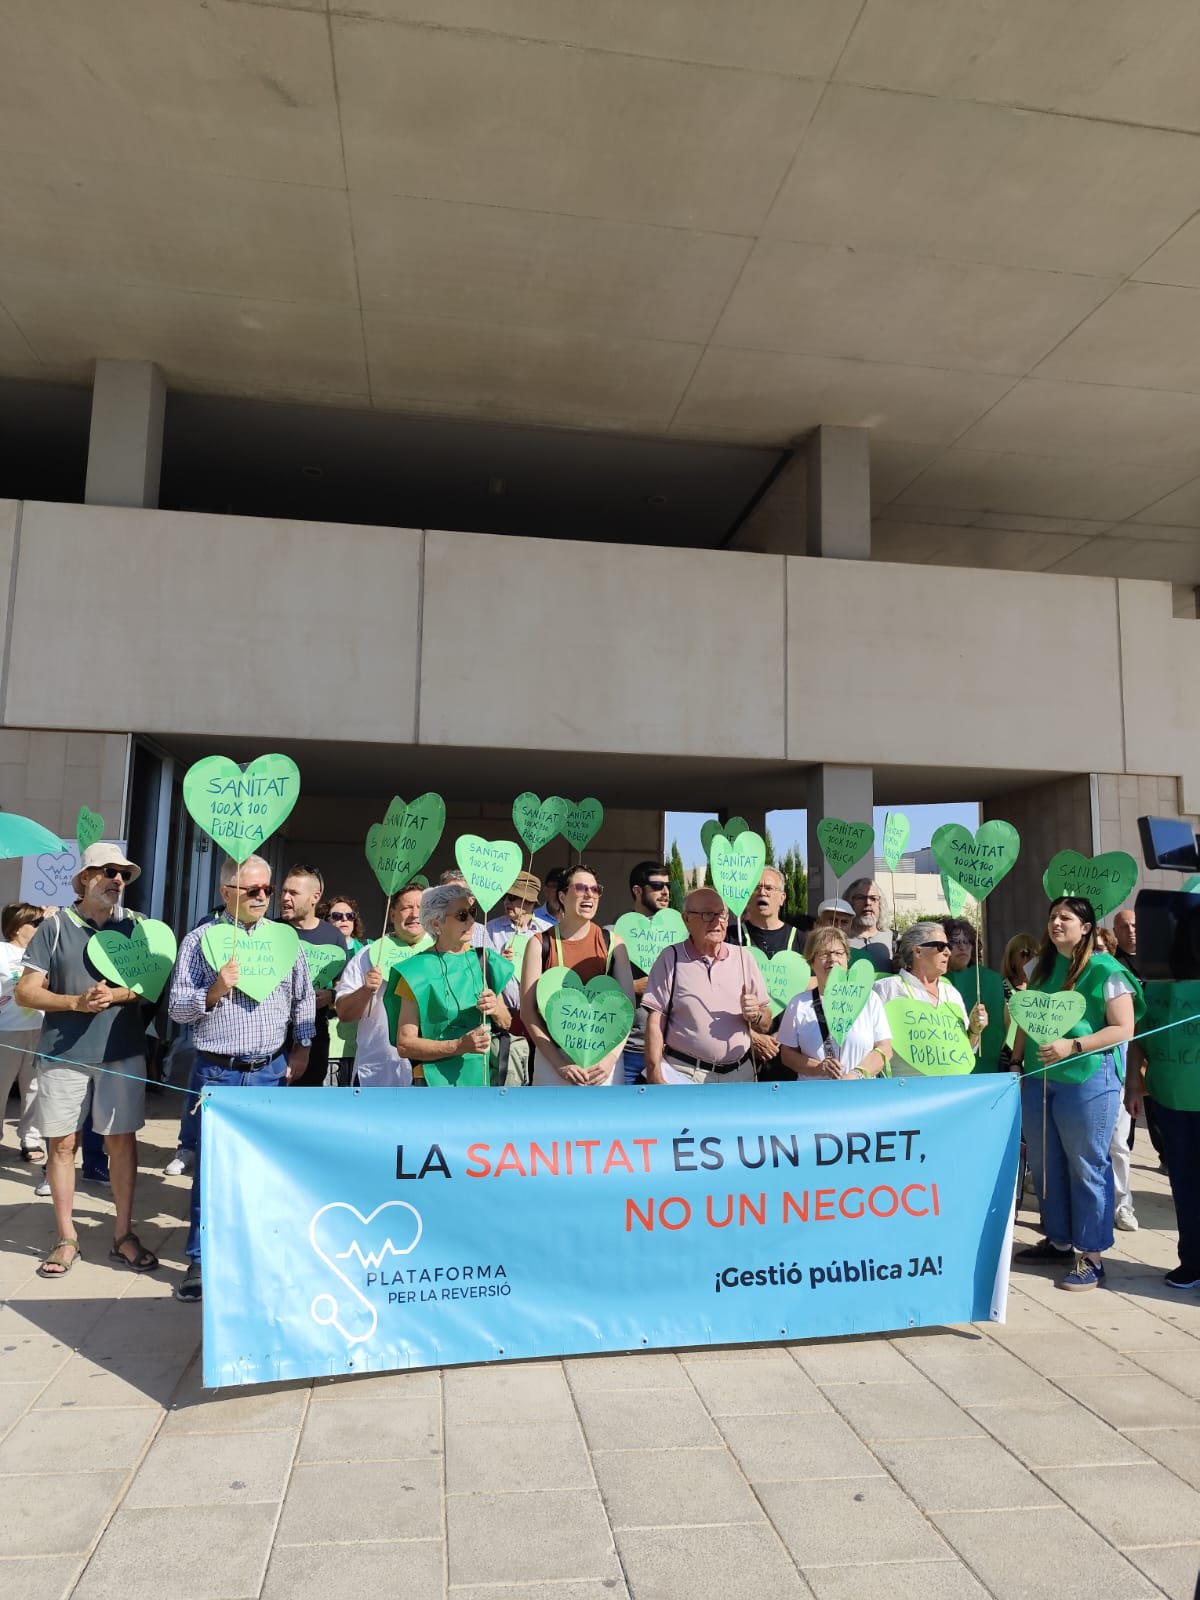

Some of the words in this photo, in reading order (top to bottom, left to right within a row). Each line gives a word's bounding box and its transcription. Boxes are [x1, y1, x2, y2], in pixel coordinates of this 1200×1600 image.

[1058, 864, 1121, 883] SANIDAD
[396, 1144, 452, 1180] LA
[465, 1138, 658, 1179] SANITAT
[672, 1128, 724, 1172] ÉS
[737, 1135, 800, 1170] UN
[814, 1130, 926, 1166] DRET,
[625, 1196, 692, 1232] NO
[706, 1192, 766, 1228] UN
[782, 1183, 940, 1225] NEGOCI
[367, 1264, 508, 1287] PLATAFORMA
[715, 1262, 803, 1293] ¡Gestió
[809, 1259, 902, 1289] pública
[907, 1255, 943, 1277] JA!
[388, 1290, 416, 1304] PER
[420, 1289, 438, 1302] LA
[441, 1282, 511, 1301] REVERSIÓ
